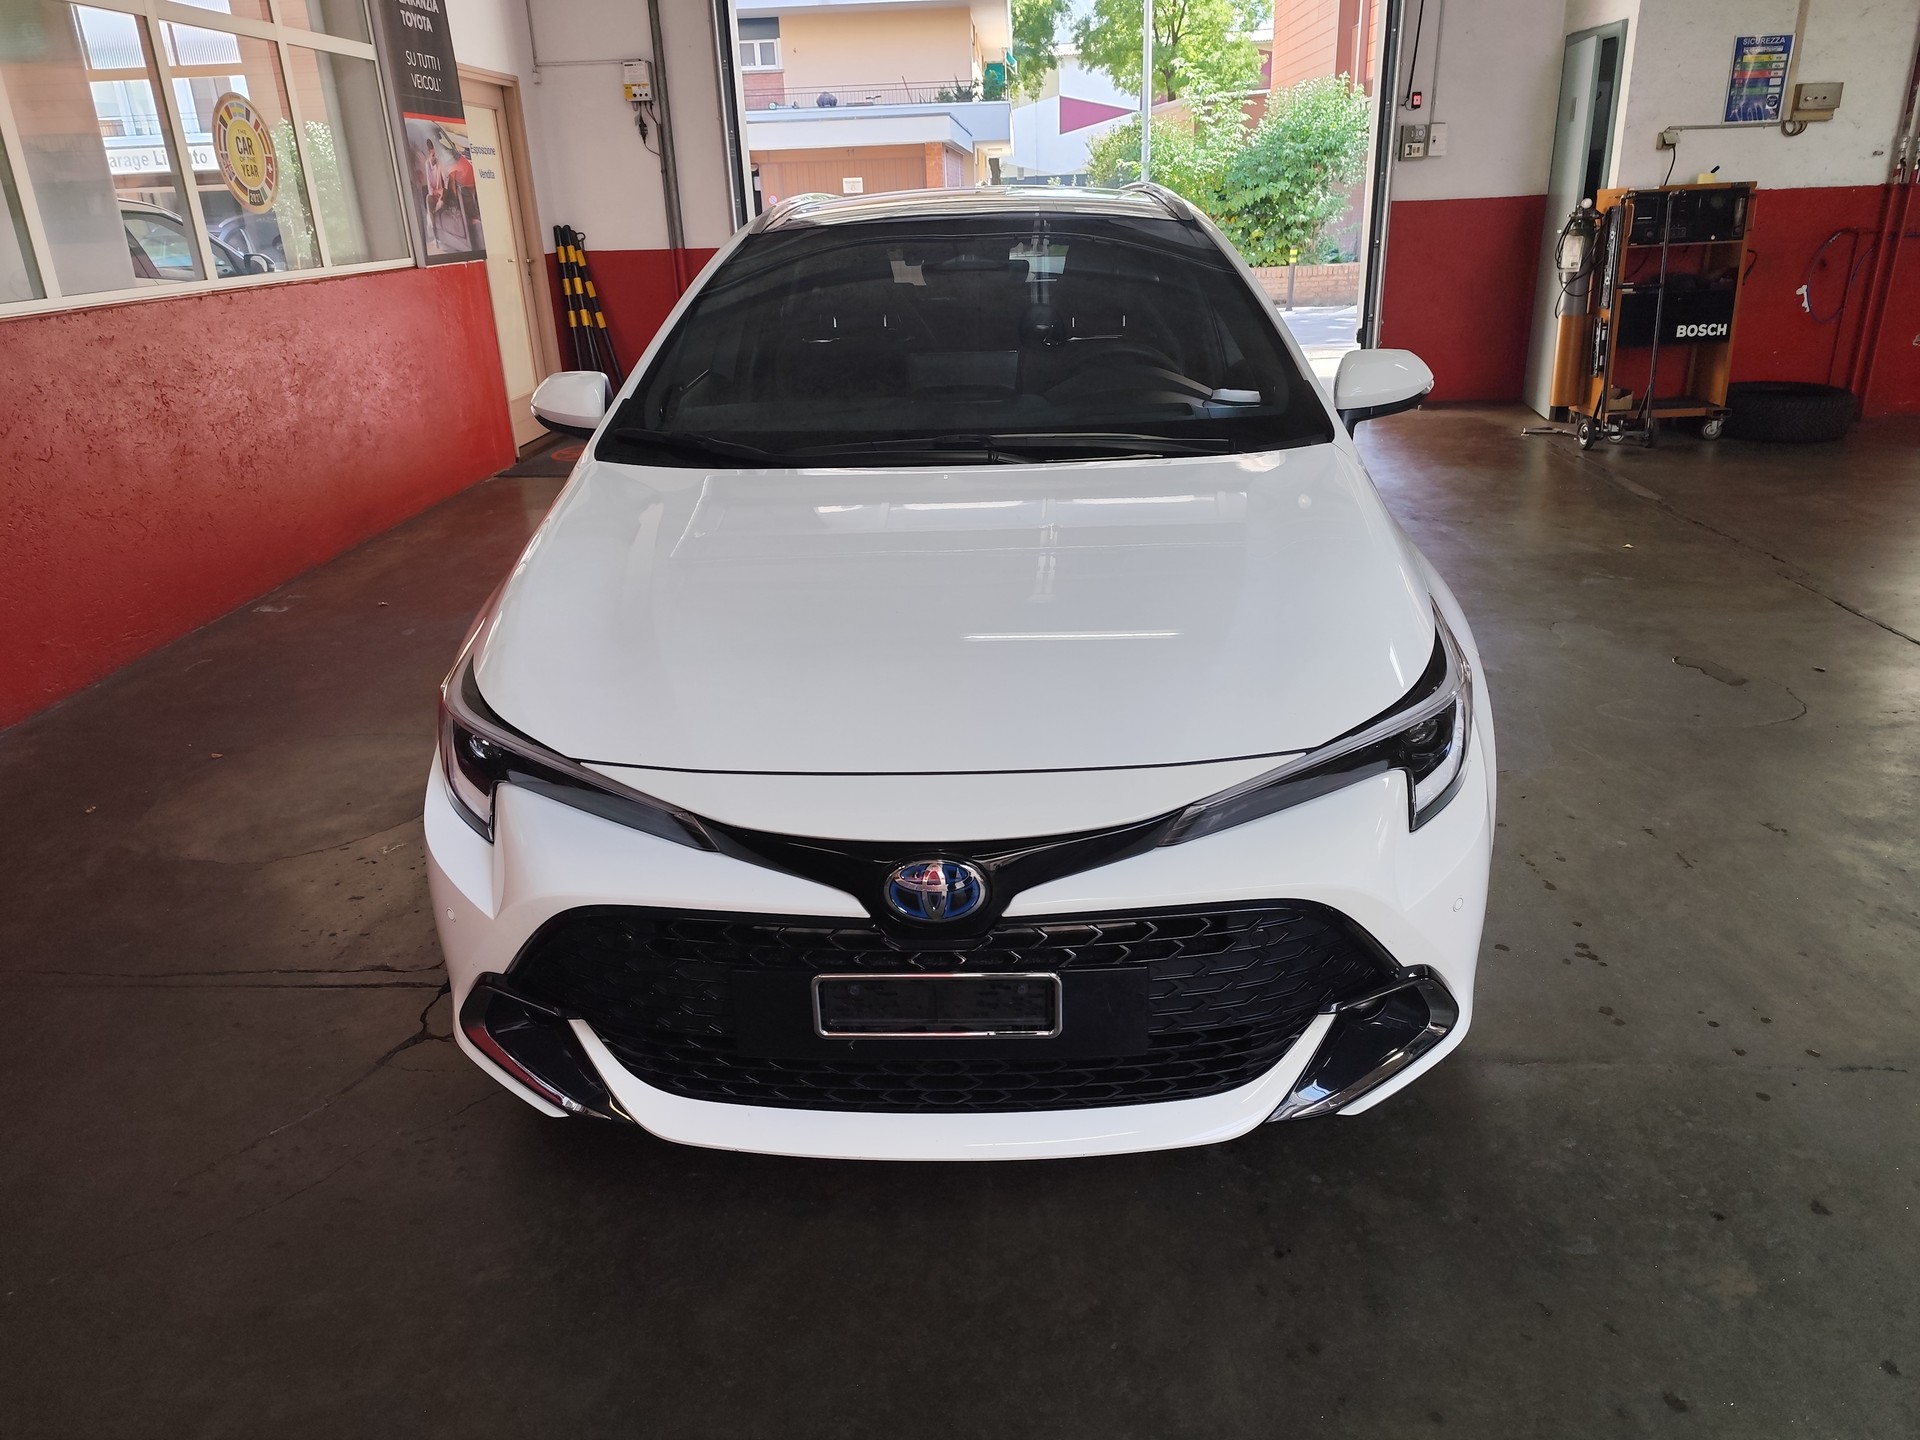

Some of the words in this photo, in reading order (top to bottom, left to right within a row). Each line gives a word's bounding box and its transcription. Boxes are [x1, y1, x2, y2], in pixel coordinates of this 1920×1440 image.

[399, 0, 439, 14] ANZIA
[400, 9, 433, 33] TOYOTA
[1743, 37, 1785, 46] SICUREZZA
[405, 50, 417, 67] SU
[416, 52, 437, 70] TUTTI
[236, 136, 255, 155] CAR
[108, 153, 149, 171] arage
[241, 164, 260, 177] YEAR
[478, 168, 496, 180] Vendita
[250, 193, 262, 203] 2021
[1675, 323, 1728, 338] BOSCH
